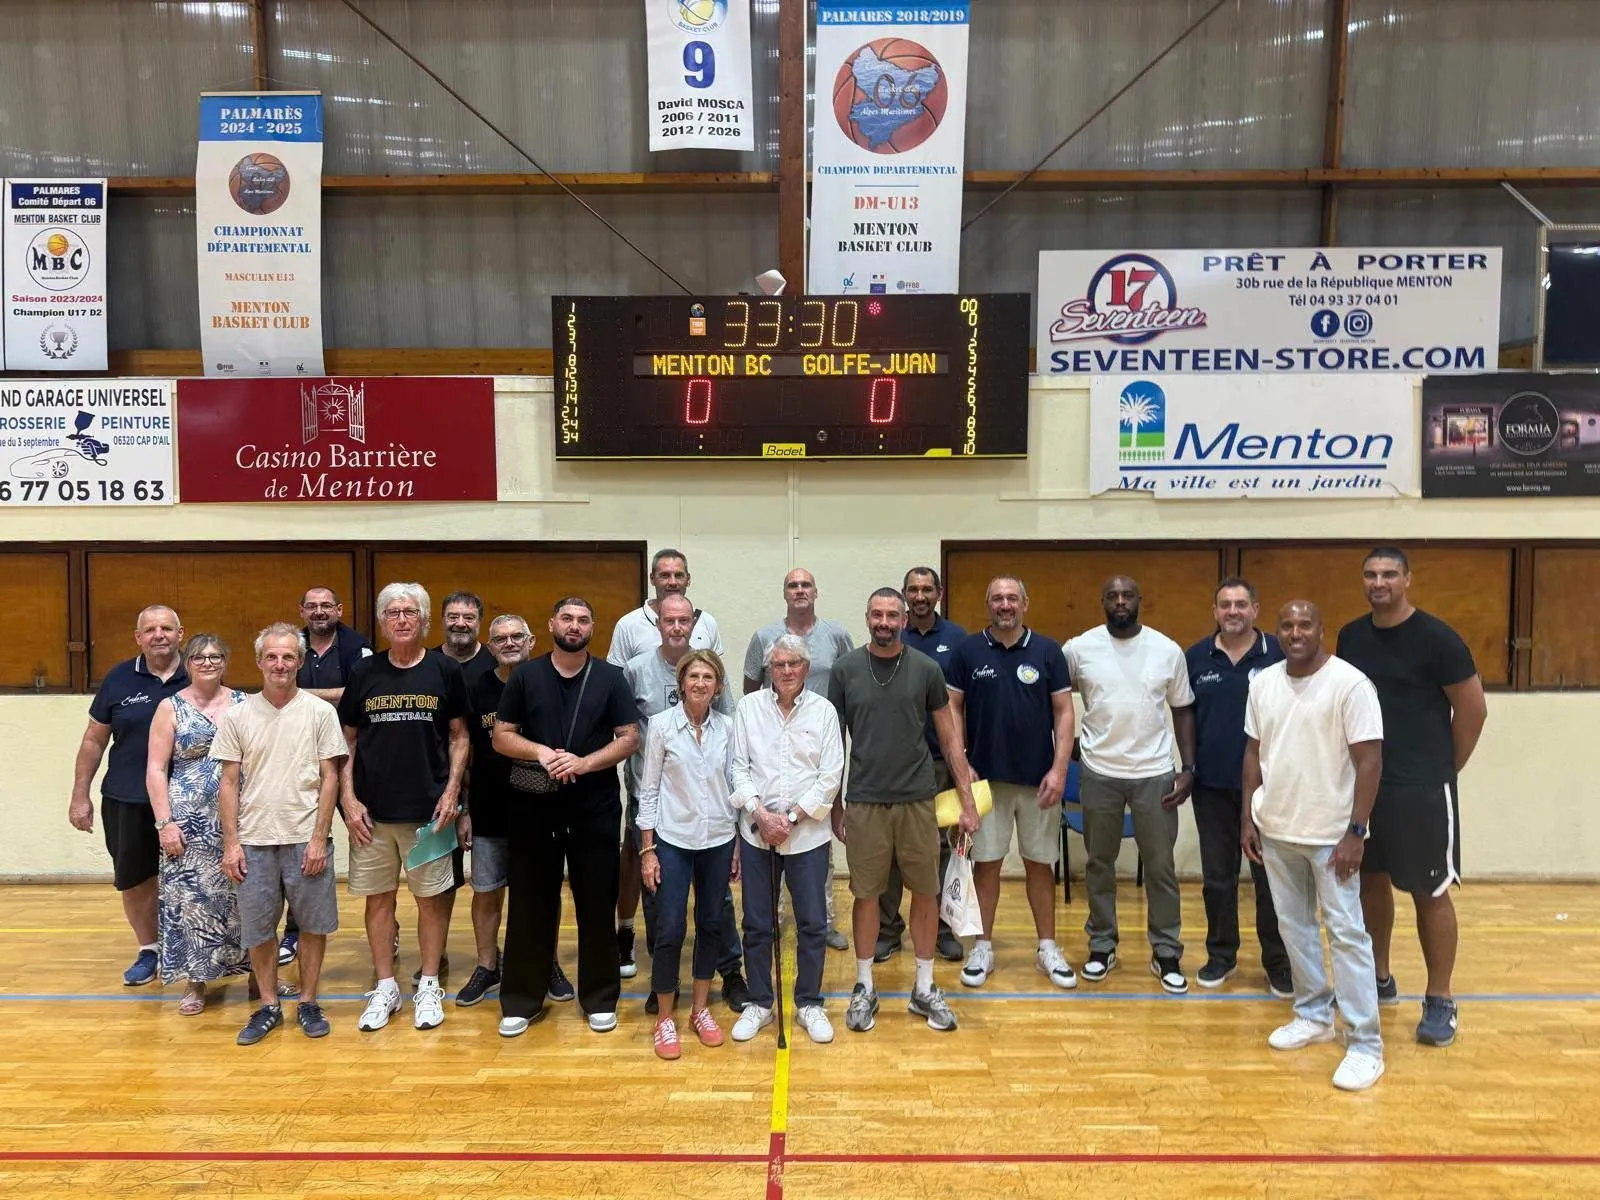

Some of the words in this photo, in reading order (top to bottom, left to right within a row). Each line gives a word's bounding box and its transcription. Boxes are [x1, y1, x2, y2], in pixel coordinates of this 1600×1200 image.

[822, 10, 892, 23] PALMARES
[896, 10, 965, 23] 2018/2019
[682, 40, 716, 88] 9
[658, 98, 693, 110] David
[697, 98, 744, 110] MOSCA
[220, 104, 302, 120] PALMARÈS
[662, 112, 694, 123] 2006
[698, 112, 704, 122] /
[708, 112, 739, 123] 2011
[220, 122, 254, 134] 2024
[266, 122, 302, 134] 2025
[662, 126, 694, 137] 2012
[698, 126, 704, 137] /
[708, 126, 740, 137] 2026
[818, 166, 870, 174] CHAMPION
[873, 165, 958, 174] DEPARTEMENTAL
[33, 186, 80, 195] PALMARES
[18, 196, 49, 206] Comité
[52, 197, 82, 208] Départ
[84, 198, 96, 206] 06
[854, 196, 919, 210] DM-U13
[14, 214, 45, 224] MENTON
[48, 214, 78, 224] BASKET
[81, 214, 100, 224] CLUB
[214, 226, 304, 237] CHAMPIONNAT
[853, 222, 918, 236] MENTON
[207, 240, 312, 253] DÉPARTEMENTAL
[838, 241, 892, 252] BASKET
[896, 241, 932, 252] CLUB
[32, 246, 83, 270] MBC
[1203, 252, 1286, 272] PRÊT
[1309, 252, 1332, 272] À
[1357, 254, 1488, 270] PORTER
[224, 272, 274, 282] MASCULIN
[276, 272, 295, 282] U13
[1236, 278, 1260, 289] 30b
[1263, 279, 1284, 289] rue
[1287, 276, 1303, 288] de
[1306, 276, 1317, 288] la
[1320, 276, 1394, 290] République
[1396, 276, 1453, 288] MENTON
[1106, 266, 1158, 312] 17
[12, 295, 48, 303] Saison
[50, 295, 103, 304] 2023/2024
[1288, 294, 1306, 306] Tél
[1310, 295, 1324, 306] 04
[1328, 295, 1344, 306] 93
[1346, 295, 1362, 306] 37
[1366, 294, 1381, 306] 04
[1384, 294, 1398, 306] 01
[13, 308, 64, 318] Champion
[232, 301, 290, 314] MENTON
[212, 316, 272, 329] BASKET
[272, 316, 310, 329] CLUB
[1051, 299, 1206, 336] Seventeen
[653, 354, 734, 376] MENTON
[745, 354, 772, 376] BC
[802, 352, 936, 376] GOLFE-JUAN
[1050, 346, 1485, 372] SEVENTEEN-STORE.COM
[26, 388, 84, 407] GARAGE
[88, 388, 166, 406] UNIVERSEL
[686, 379, 712, 424] 0
[870, 378, 896, 423] 0
[102, 416, 170, 429] PEINTURE
[1505, 424, 1552, 434] FORMIA
[8, 437, 16, 447] du
[18, 438, 22, 447] 3
[23, 436, 60, 449] septembre
[114, 436, 134, 446] 06320
[136, 436, 151, 446] CAP
[152, 436, 170, 446] D'AIL
[1173, 422, 1393, 460] Menton
[236, 444, 321, 469] Casino
[329, 442, 437, 468] Barrière
[765, 444, 804, 457] Bodet
[264, 478, 288, 498] de
[297, 473, 414, 498] Menton
[1117, 476, 1156, 490] Ma
[1170, 475, 1216, 490] ville
[1228, 476, 1260, 489] est
[1272, 477, 1300, 489] un
[1308, 474, 1382, 491] jardin
[0, 480, 12, 501] 6
[20, 480, 50, 501] 77
[58, 480, 90, 501] 05
[98, 480, 124, 501] 18
[134, 480, 164, 501] 63
[365, 694, 439, 712] MENTON
[369, 712, 434, 724] BASKETBALL
